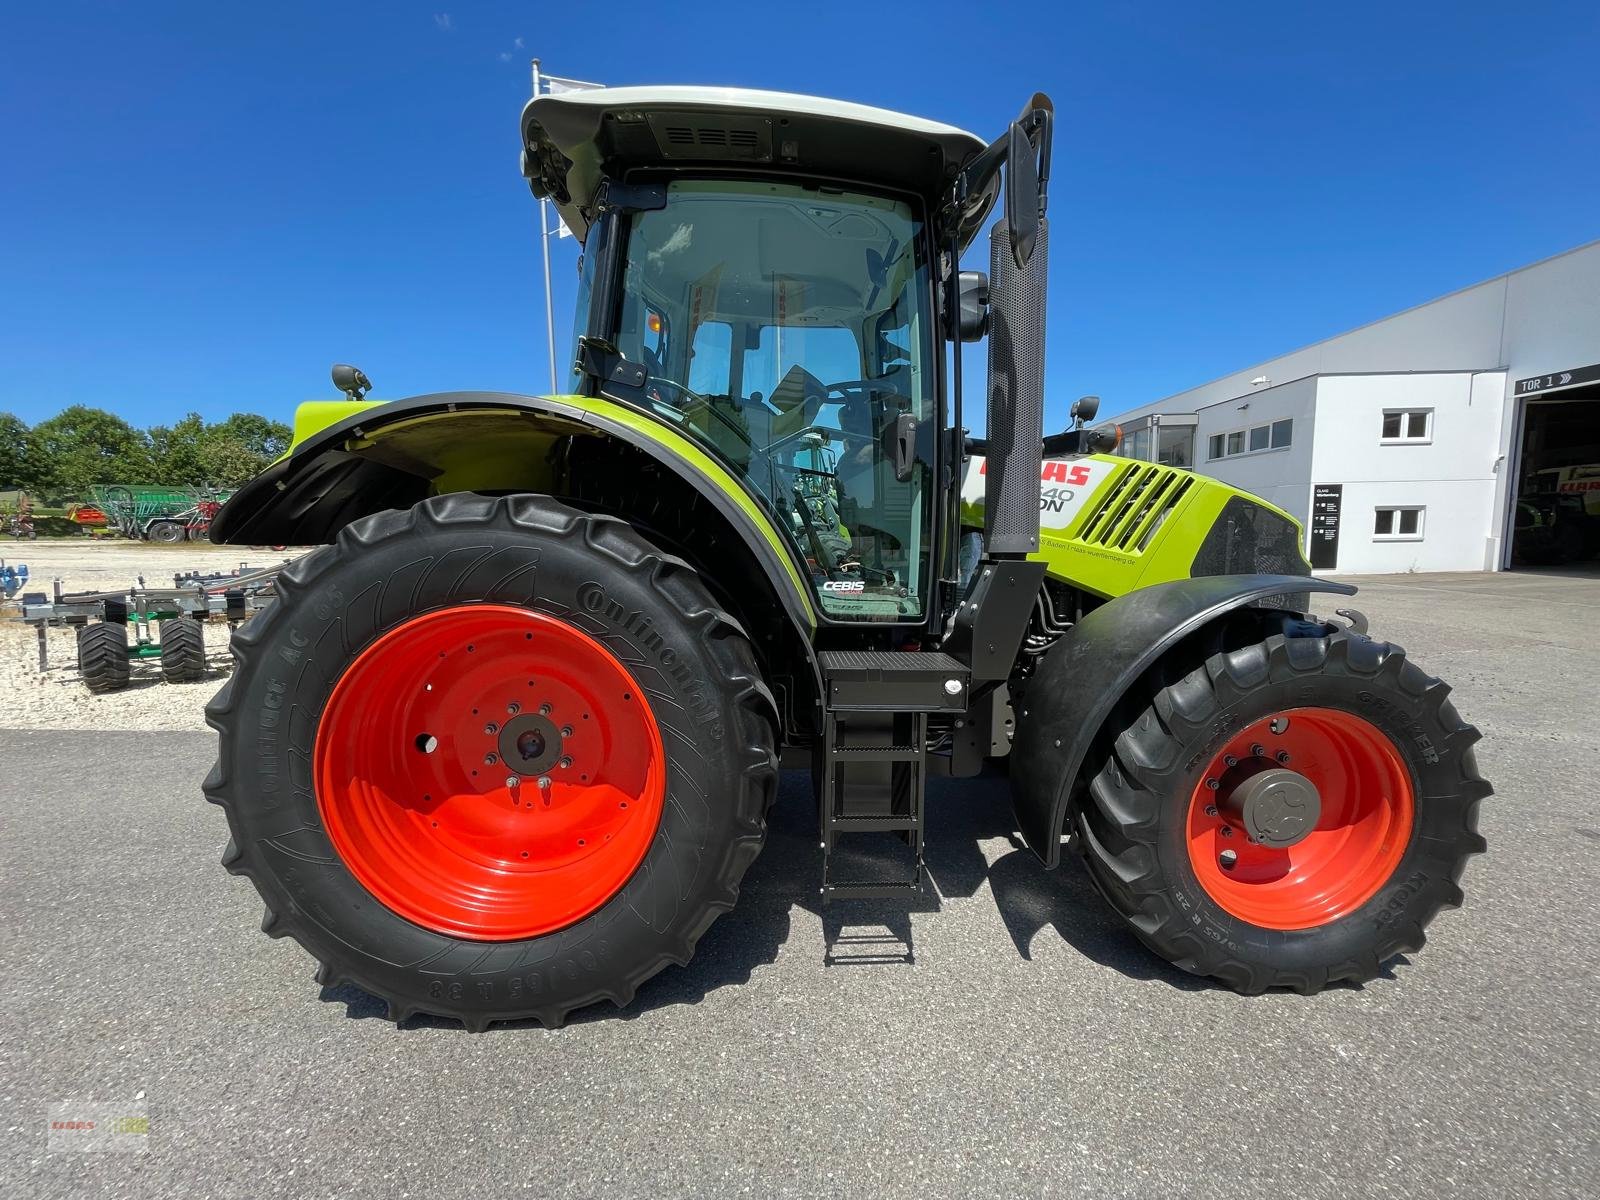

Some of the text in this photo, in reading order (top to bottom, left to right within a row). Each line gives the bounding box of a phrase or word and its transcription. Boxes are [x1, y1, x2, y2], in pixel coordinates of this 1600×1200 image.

[1521, 376, 1554, 392] TOR 1
[823, 581, 866, 591] CEBIS
[279, 628, 310, 667] AC
[428, 979, 465, 1001] 38
